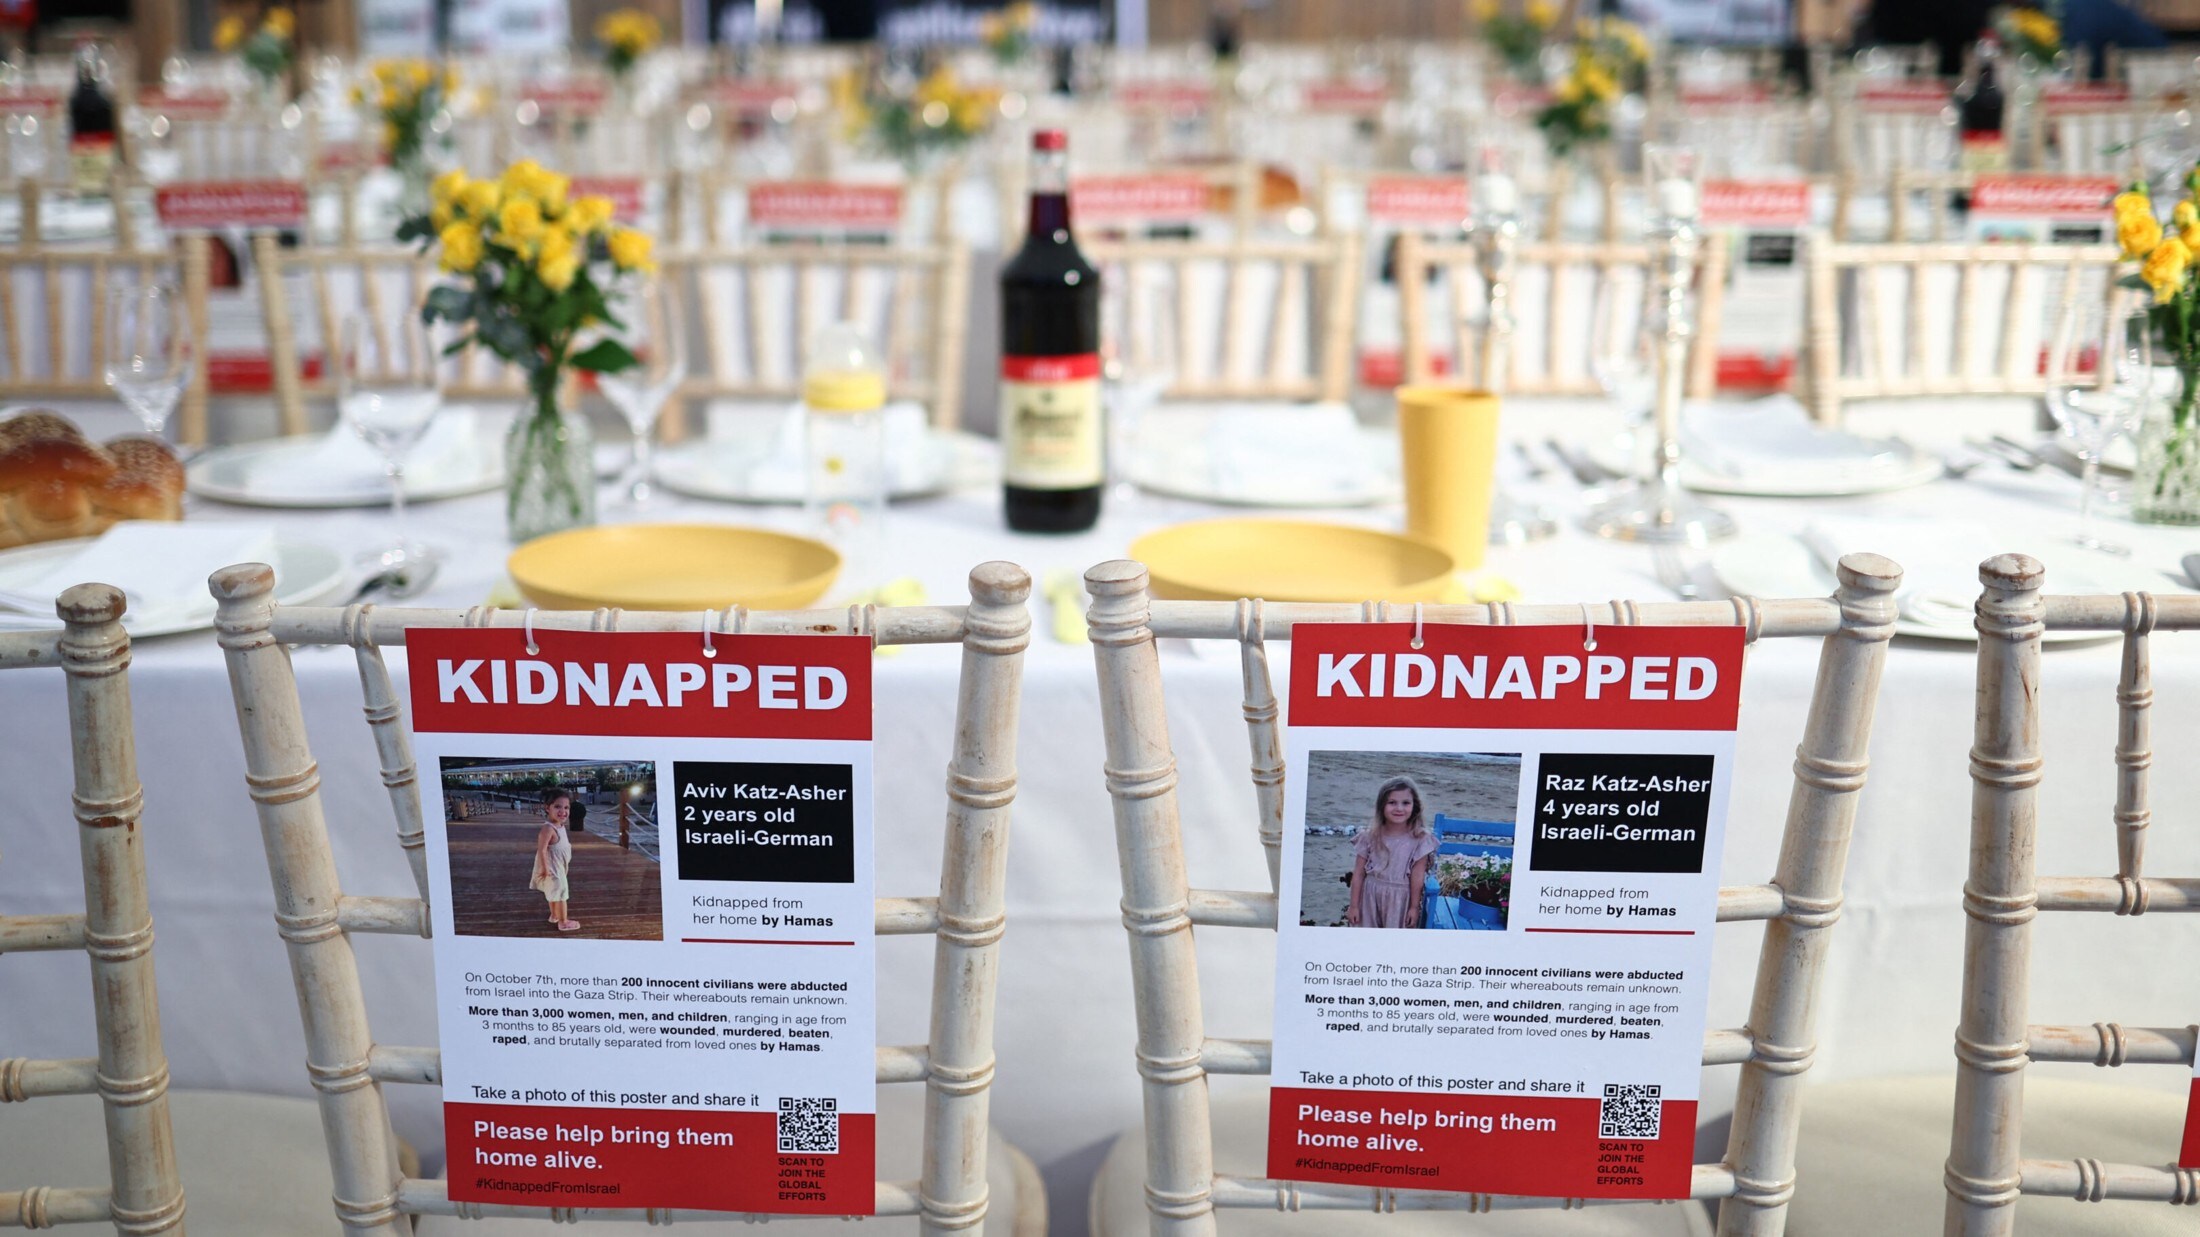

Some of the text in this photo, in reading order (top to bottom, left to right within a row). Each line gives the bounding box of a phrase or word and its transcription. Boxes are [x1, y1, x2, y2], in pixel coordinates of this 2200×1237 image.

[436, 659, 848, 710] KIDNAPPED
[1316, 653, 1718, 701] KIDNAPPED
[682, 782, 847, 801] Aviv Katz-Asher
[1545, 774, 1711, 793] Raz Katz-Asher
[684, 805, 795, 826] 2 years old
[1542, 798, 1660, 820] 4 years old
[685, 828, 833, 847] Israeli-German
[1541, 823, 1696, 842] Israeli-German
[692, 895, 803, 911] Kidnapped from
[1540, 886, 1649, 901] Kidnapped from
[1538, 903, 1677, 918] her home by Hamas
[693, 912, 834, 929] her home by Hamas
[1304, 961, 1684, 981] On October 7th, more than 200 innocent civilians were abducted
[464, 972, 848, 992] On October 7th, more than 200 innocent civilians were abducted
[1303, 974, 1682, 994] from Israel into the Gaza Strip. Their whereabouts remain unknown.
[1304, 993, 1679, 1015] More than 3,000 women, men, and children, ranging in age from
[468, 1005, 847, 1027] More than 3,000 women, men, and children, ranging in age from
[482, 1019, 833, 1039] 3 months to 85 years old, were wounded, murdered, beaten,
[1325, 1022, 1655, 1041] raped, and brutally separated from loved ones by Hamas.
[492, 1034, 825, 1053] raped, and brutally separated from loved ones by Hamas.
[1299, 1070, 1585, 1093] Take a photo of this poster and share it
[471, 1085, 759, 1107] Take a photo of this poster and share it
[1298, 1104, 1556, 1134] Please help bring them
[474, 1120, 734, 1149] Please help bring them
[1297, 1129, 1424, 1152] home alive.
[1598, 1142, 1644, 1152] SCAN TO
[475, 1147, 603, 1169] home alive.
[778, 1157, 825, 1167] SCAN TO
[1295, 1158, 1440, 1177] #KidnappedFromIsrael
[1597, 1153, 1645, 1164] JOIN THE
[778, 1167, 826, 1179] JOIN THE
[1597, 1164, 1640, 1174] GLOBAL
[475, 1177, 620, 1195] #KidnappedFromIsrael
[778, 1179, 822, 1190] GLOBAL
[1596, 1176, 1644, 1186] EFFORTS
[778, 1191, 827, 1202] EFFORTS
